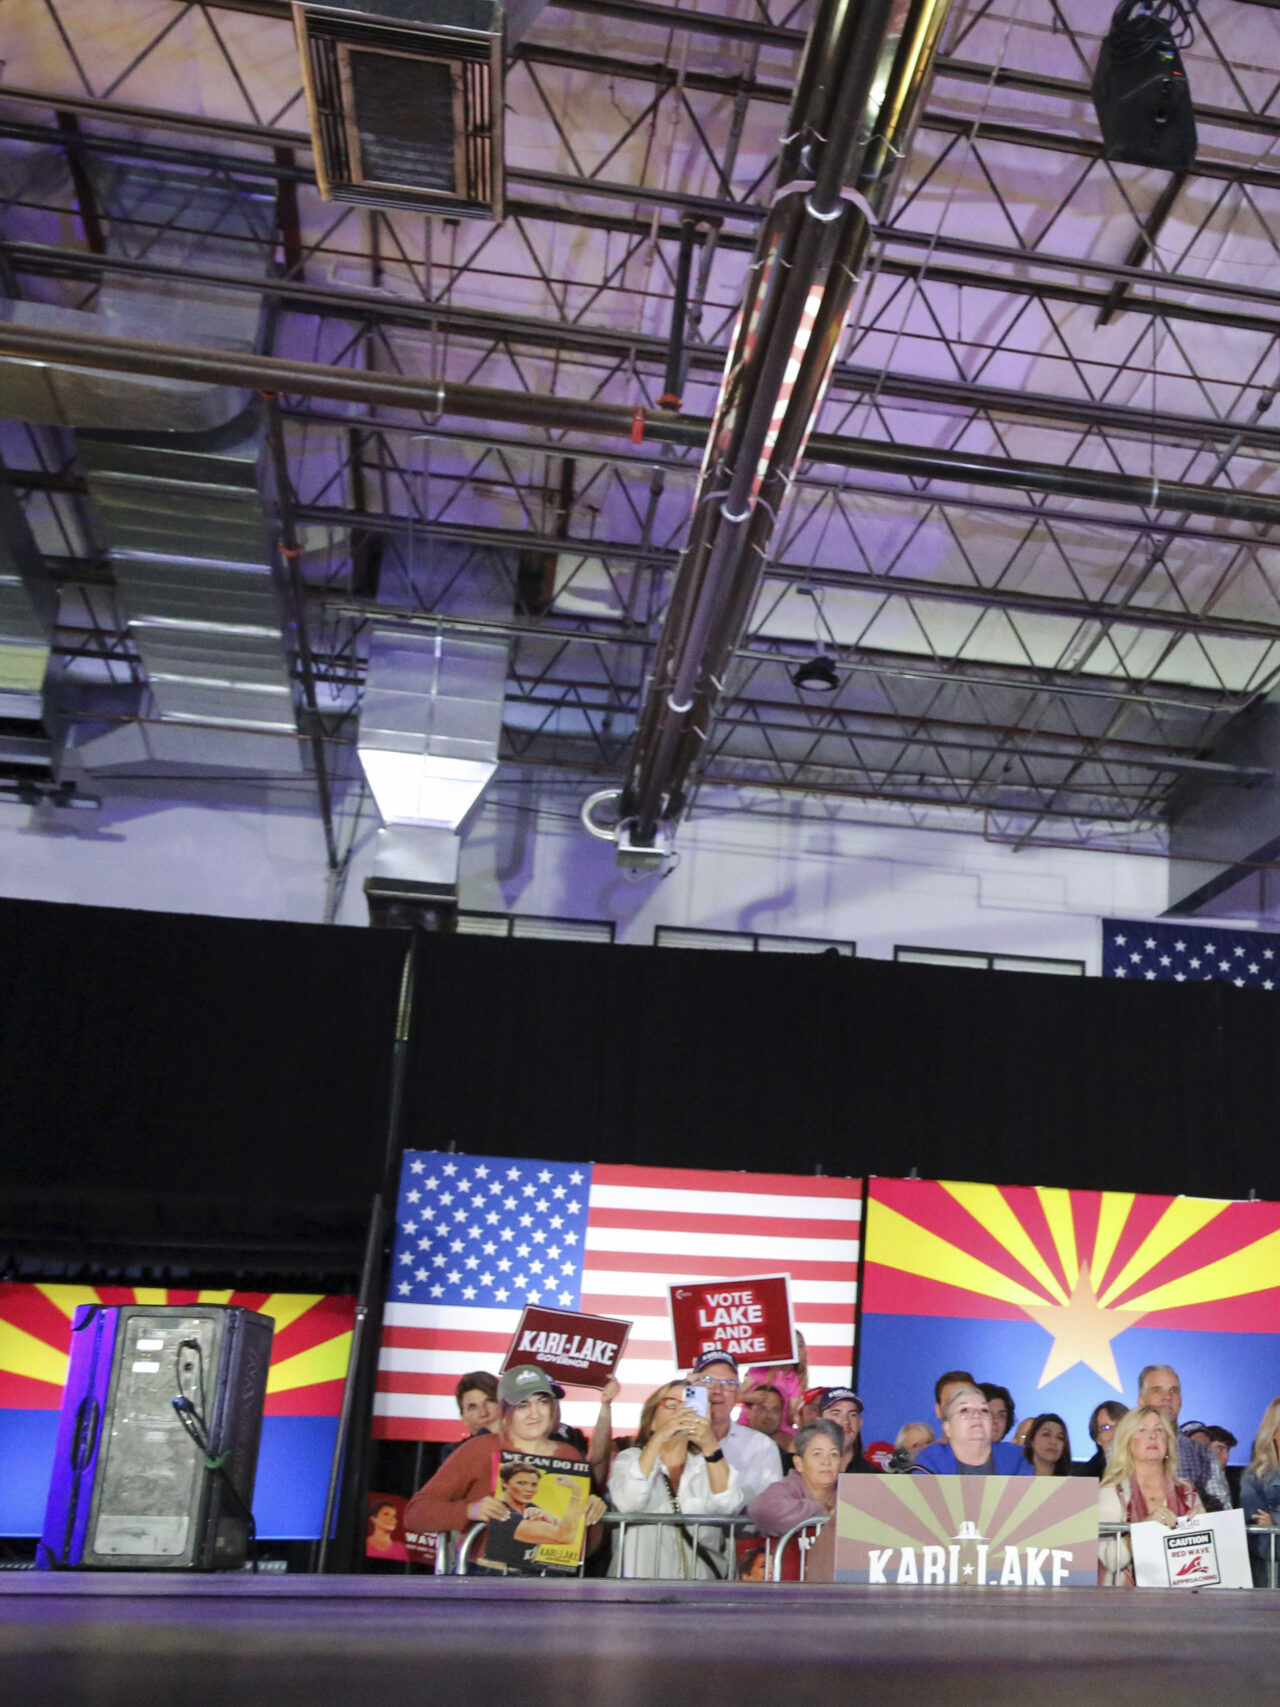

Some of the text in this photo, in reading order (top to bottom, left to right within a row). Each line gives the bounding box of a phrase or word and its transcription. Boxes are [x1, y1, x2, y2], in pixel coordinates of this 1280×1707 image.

[706, 1291, 753, 1307] VOTE
[699, 1304, 763, 1327] LAKE
[714, 1325, 752, 1340] AND
[518, 1330, 618, 1366] KARI LAKE
[536, 1353, 590, 1369] GOVERNOR
[502, 1451, 590, 1473] WE CAN DO IT!
[405, 1531, 437, 1547] WAV
[1169, 1534, 1209, 1547] CAUTION
[1188, 1547, 1210, 1555] WAVE
[868, 1544, 1073, 1587] KARI LAKE
[1173, 1575, 1217, 1585] APPROACHING
